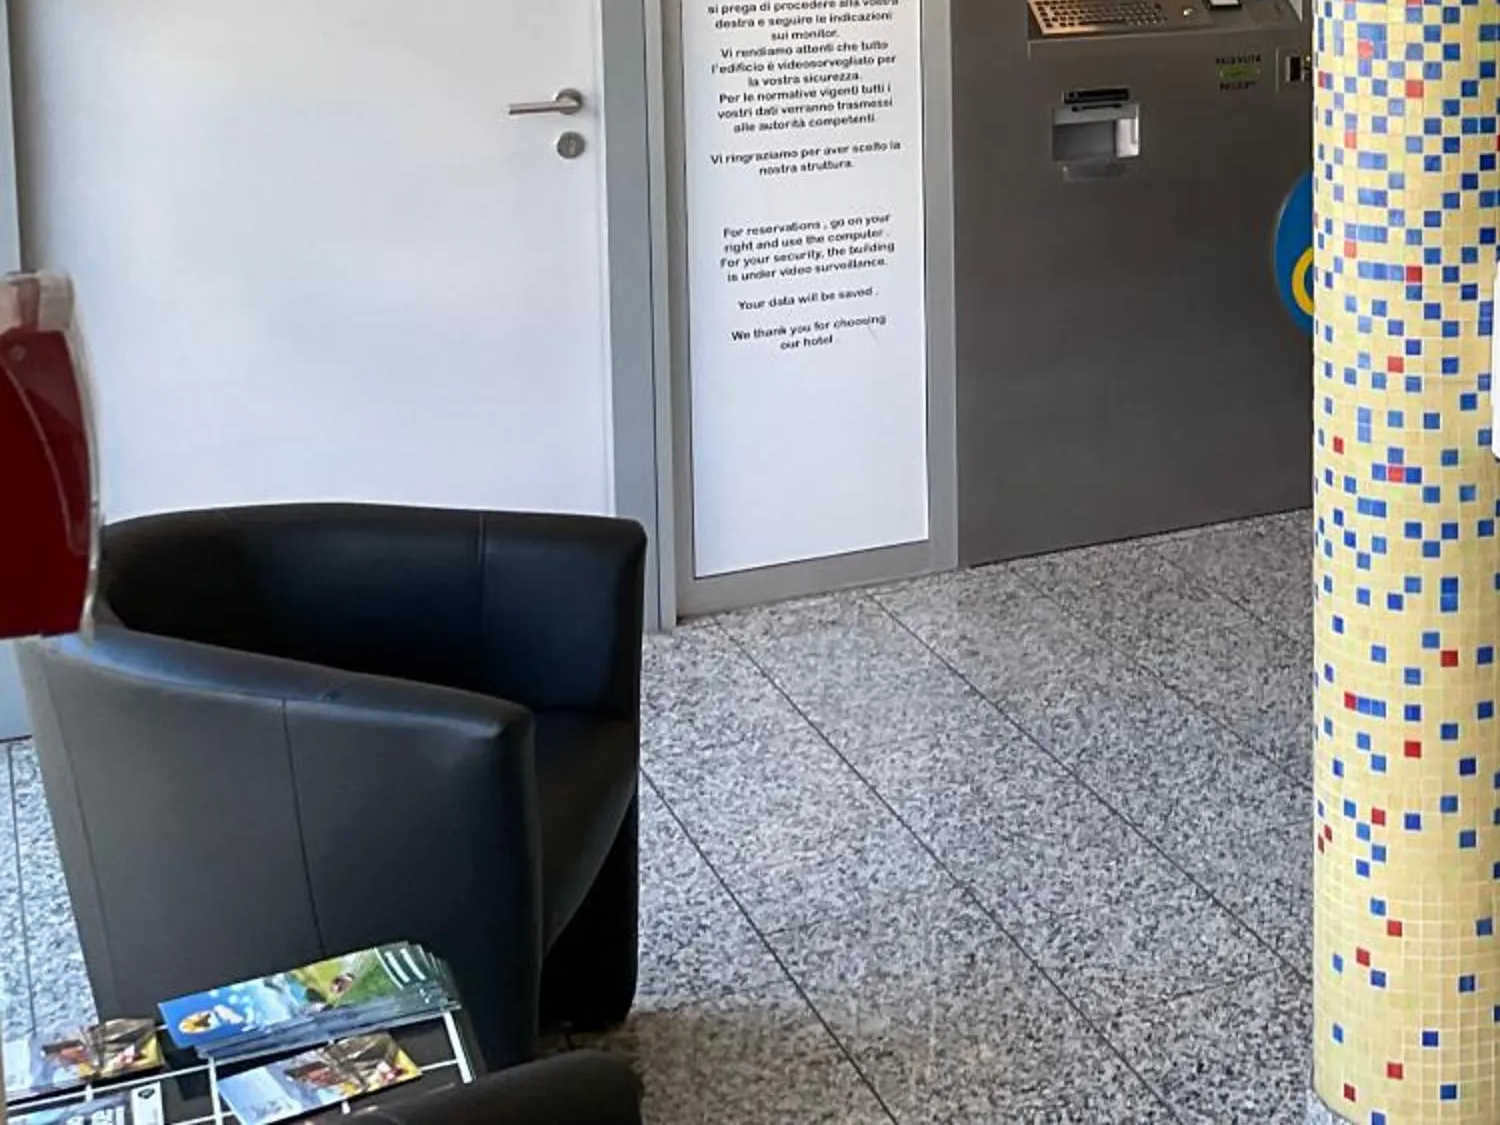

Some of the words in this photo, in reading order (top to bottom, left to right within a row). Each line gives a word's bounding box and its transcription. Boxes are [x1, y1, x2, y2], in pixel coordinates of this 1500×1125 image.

[708, 5, 719, 14] si
[721, 4, 757, 15] prega
[759, 1, 771, 11] di
[773, 0, 836, 13] procedere
[715, 18, 755, 28] destra
[757, 19, 766, 27] e
[768, 15, 813, 28] seguire
[815, 14, 828, 24] le
[829, 11, 893, 23] indicazioni
[720, 48, 733, 58] Vi
[735, 46, 793, 58] rendiamo
[795, 43, 834, 54] attenti
[837, 42, 858, 52] che
[861, 40, 889, 50] tutto
[748, 76, 760, 87] la
[762, 73, 800, 85] vostra
[719, 92, 740, 104] Per
[743, 91, 754, 102] le
[757, 87, 817, 101] normative
[819, 85, 859, 99] vigenti
[861, 83, 885, 94] tutti
[887, 82, 892, 92] i
[717, 106, 753, 119] vostri
[755, 104, 779, 116] dati
[781, 102, 835, 114] verranno
[837, 98, 894, 110] trasmessi
[710, 154, 723, 165] Vi
[725, 150, 799, 165] ringraziamo
[801, 148, 821, 159] per
[823, 146, 850, 156] aver
[852, 141, 888, 153] scelto
[889, 140, 901, 150] la
[759, 163, 798, 176] nostra
[723, 227, 743, 239] For
[829, 219, 845, 230] go
[847, 216, 863, 227] on
[865, 214, 890, 227] your
[724, 241, 753, 255] right
[755, 237, 779, 249] and
[781, 237, 803, 247] use
[805, 234, 825, 244] the
[827, 228, 884, 242] computer
[720, 256, 740, 268] For
[743, 255, 770, 269] your
[827, 246, 847, 257] the
[849, 241, 895, 254] building
[727, 273, 739, 282] is
[741, 269, 777, 281] under
[779, 264, 813, 277] video
[738, 299, 766, 311] Your
[768, 295, 796, 308] data
[797, 291, 819, 303] will
[820, 291, 836, 302] be
[837, 286, 873, 300] saved
[730, 330, 752, 342] We
[753, 325, 787, 339] thank
[789, 323, 812, 337] you
[813, 320, 831, 331] for
[832, 314, 887, 328] choosing
[779, 339, 801, 350] our
[803, 334, 834, 347] hotel
